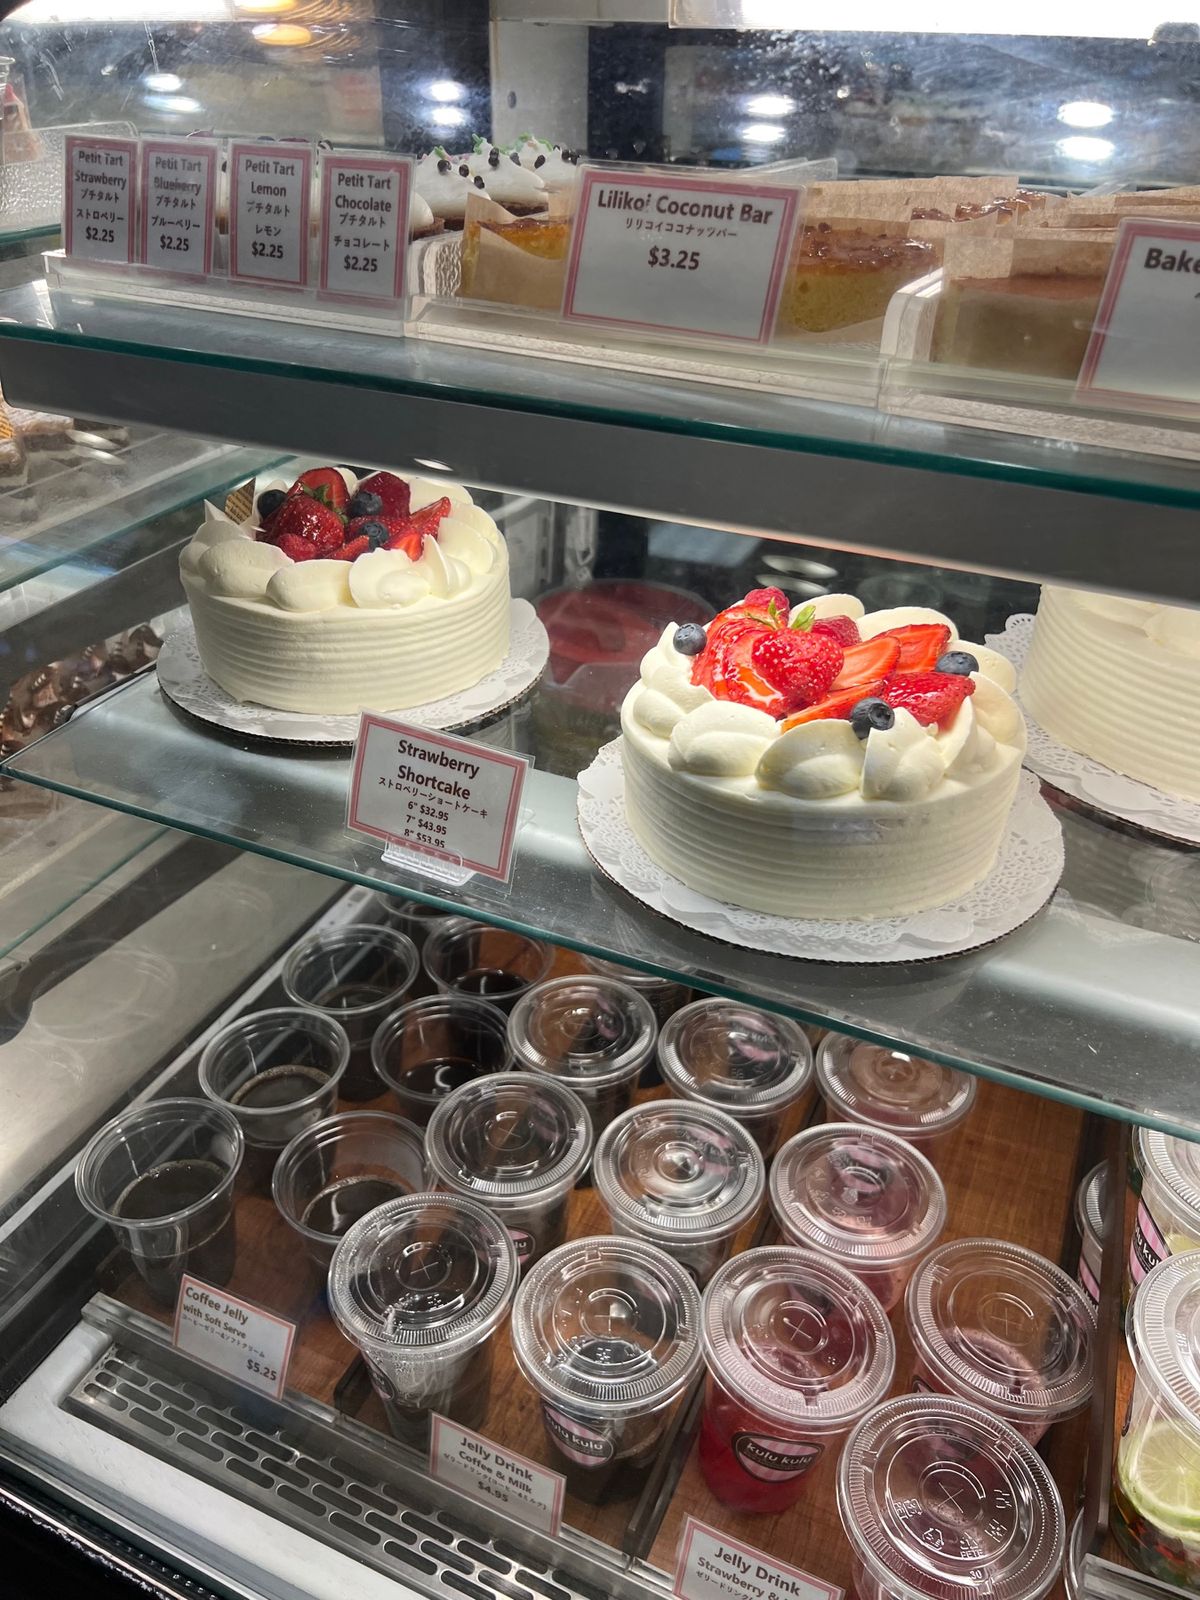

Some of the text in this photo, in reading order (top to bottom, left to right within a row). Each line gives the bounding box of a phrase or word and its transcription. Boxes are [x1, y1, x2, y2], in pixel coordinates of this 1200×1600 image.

[78, 150, 123, 167] Petit Tart
[155, 156, 202, 172] Petit Tart
[245, 159, 295, 176] Petit Tart
[75, 171, 127, 190] Strawberry
[338, 173, 391, 190] Petit Tart
[251, 182, 287, 198] Lemon
[335, 195, 392, 212] Chocolate
[656, 195, 735, 220] Coconut
[740, 204, 773, 225] Bar
[339, 212, 386, 229] プチタルト
[86, 226, 115, 243] $2.25
[255, 224, 281, 237] レモン
[159, 234, 189, 252] $2.25
[251, 241, 284, 259] $2.25
[333, 235, 390, 252] チョコレート
[344, 254, 378, 273] $2.25
[648, 246, 700, 271] $3.25
[397, 739, 480, 779] Strawberry
[397, 765, 471, 800] Shortcake
[420, 804, 449, 821] $32.95
[417, 818, 447, 835] $43.95
[416, 832, 445, 848] $53.95
[185, 1286, 249, 1326] Coffee Jelly
[183, 1303, 247, 1339] with Soft Serve
[246, 1358, 278, 1381] $5.25
[572, 1435, 603, 1450] kulu
[460, 1437, 534, 1482] Jelly Drink
[747, 1442, 812, 1465] kulu kulu
[458, 1450, 533, 1494] Coffee & Milk
[697, 1556, 765, 1598] Strawberry
[714, 1547, 800, 1597] Jelly Drink
